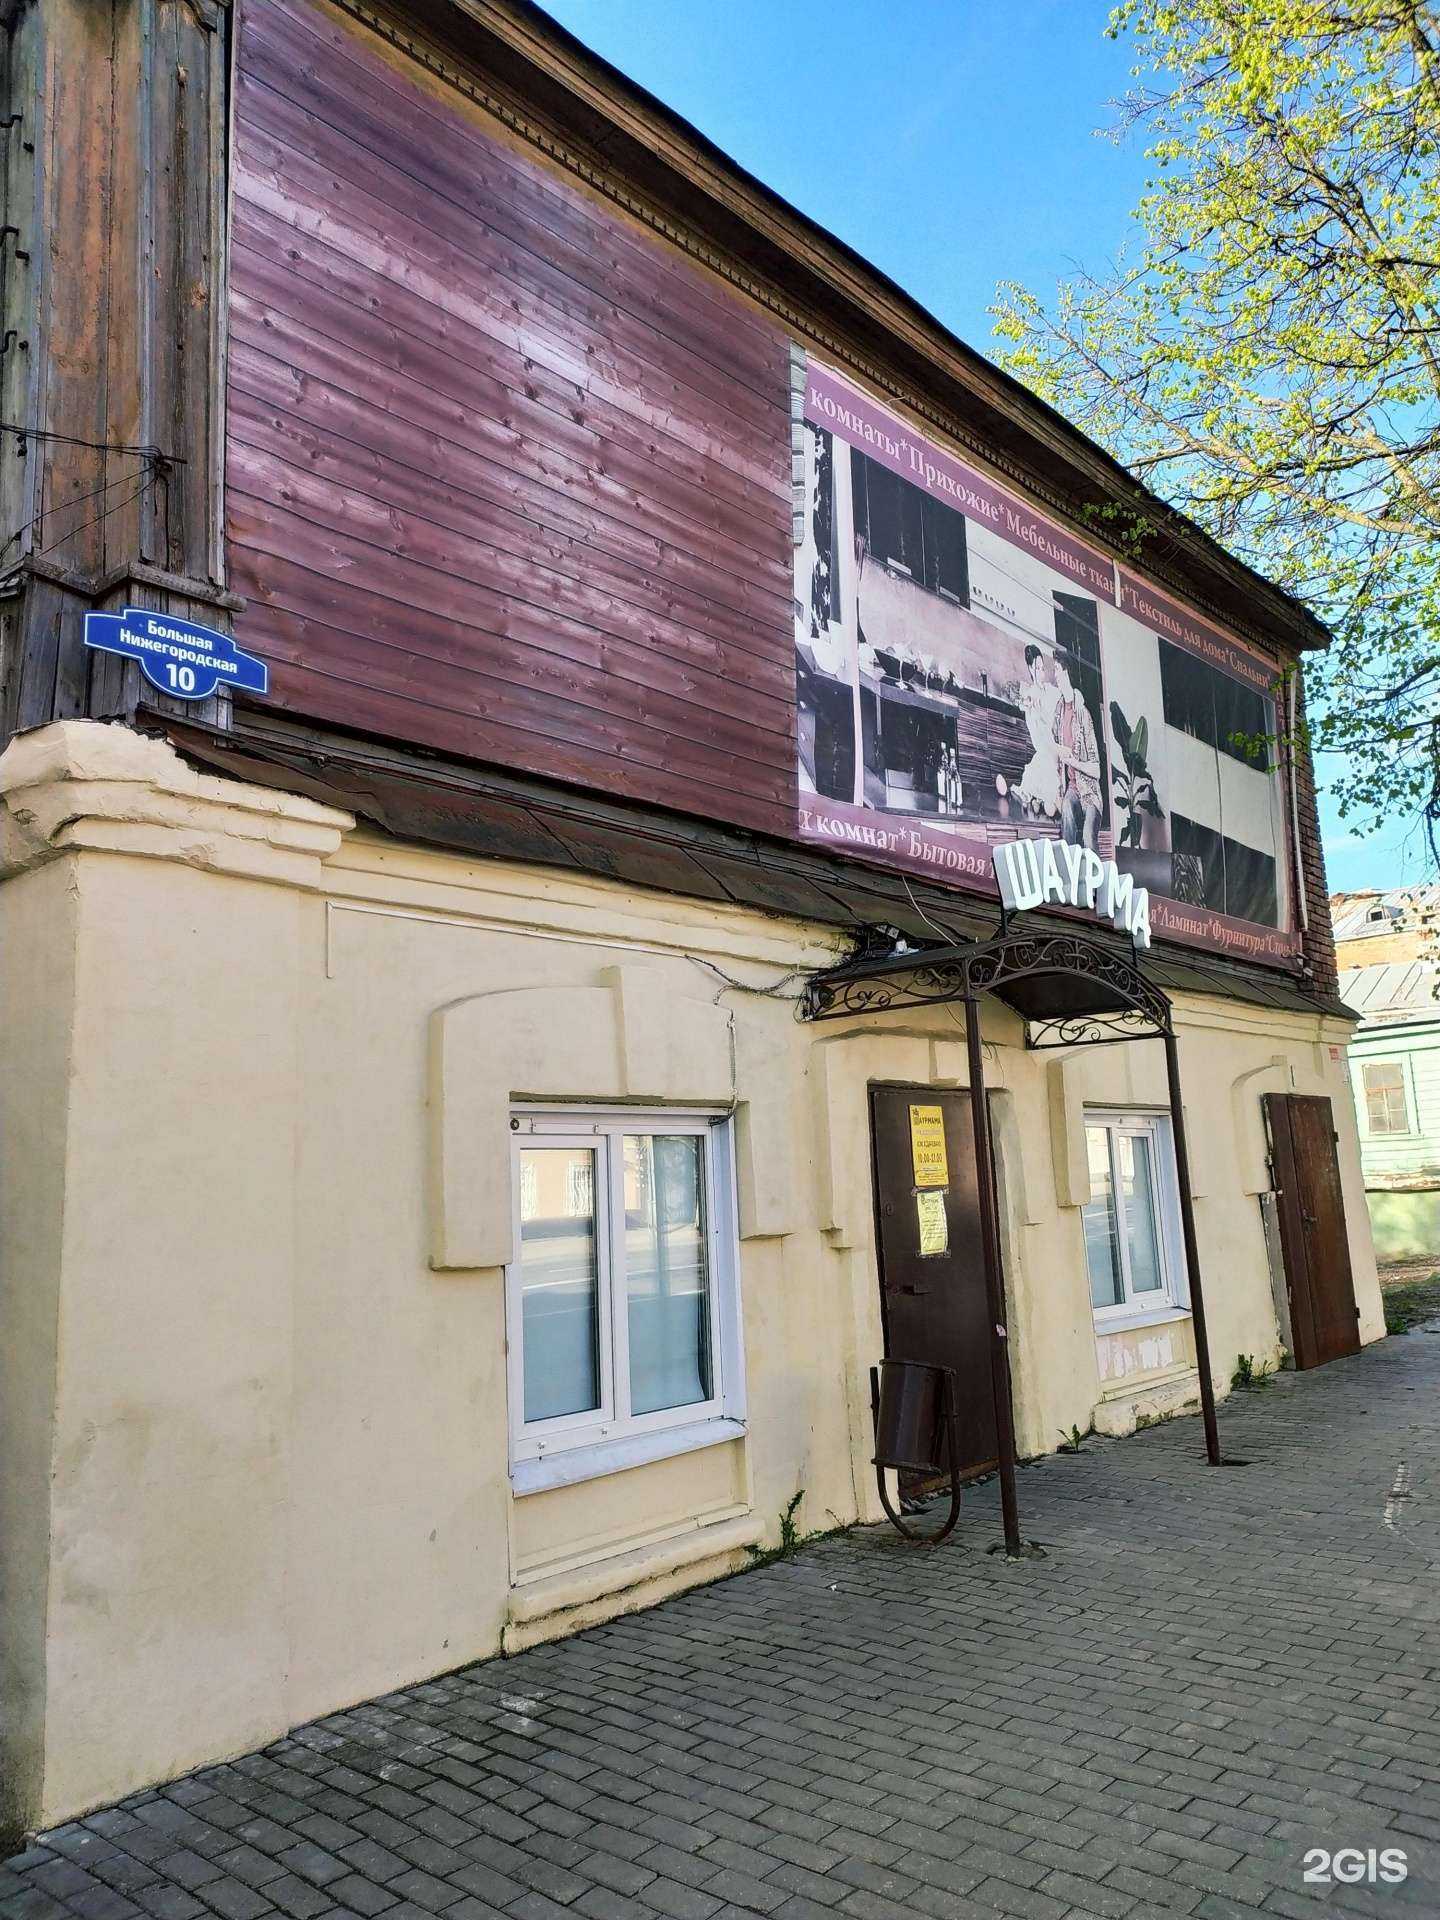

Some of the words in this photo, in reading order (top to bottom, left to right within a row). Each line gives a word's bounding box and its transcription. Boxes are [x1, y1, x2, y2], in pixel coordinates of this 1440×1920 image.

[120, 628, 238, 674] Нижегородская
[147, 619, 213, 651] Большая
[166, 663, 195, 691] 10
[816, 816, 899, 852] комнат
[907, 830, 986, 878] Бытовая
[993, 838, 1151, 948] ШАУРМА
